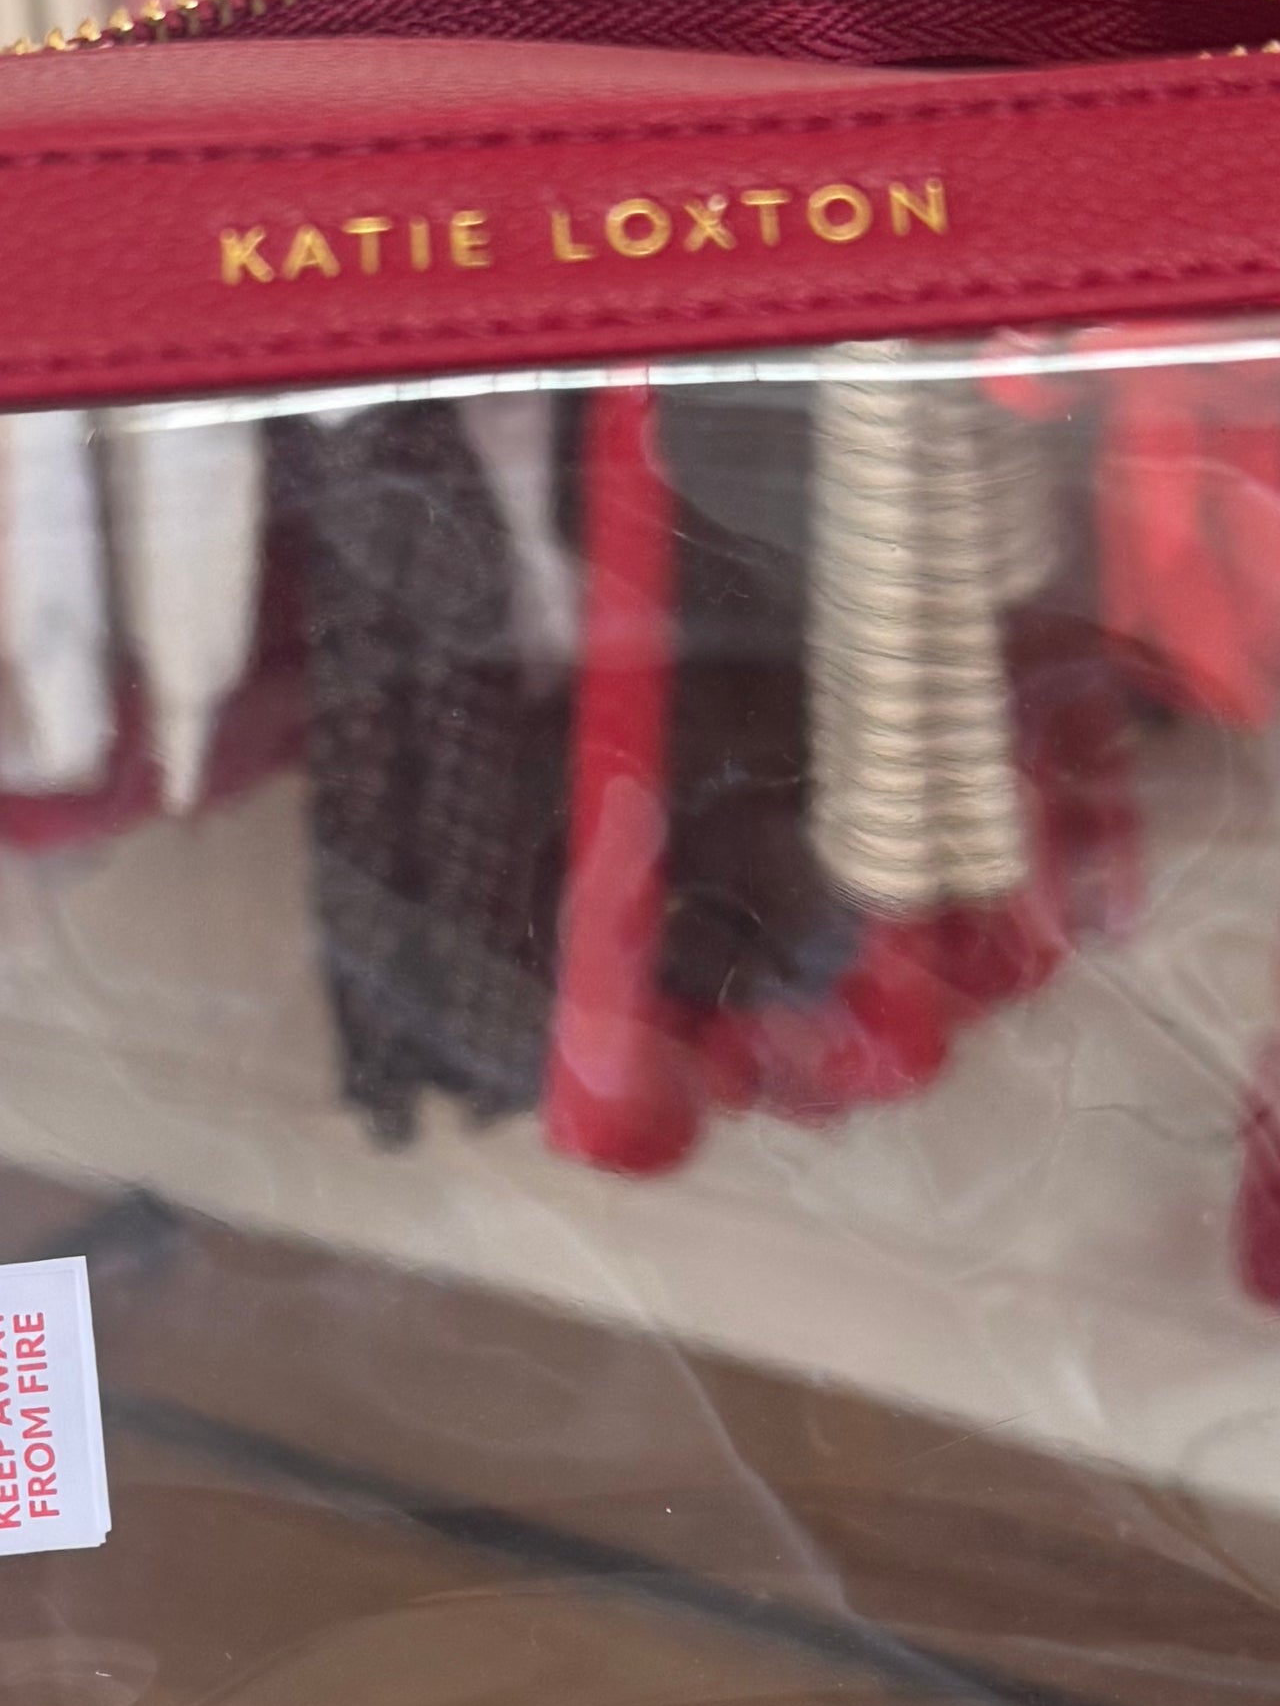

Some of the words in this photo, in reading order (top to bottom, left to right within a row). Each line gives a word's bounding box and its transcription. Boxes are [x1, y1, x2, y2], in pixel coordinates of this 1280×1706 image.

[220, 208, 492, 286] KATIE
[549, 177, 948, 262] LOXTON
[12, 1312, 49, 1394] FIRE
[19, 1406, 60, 1518] FROM
